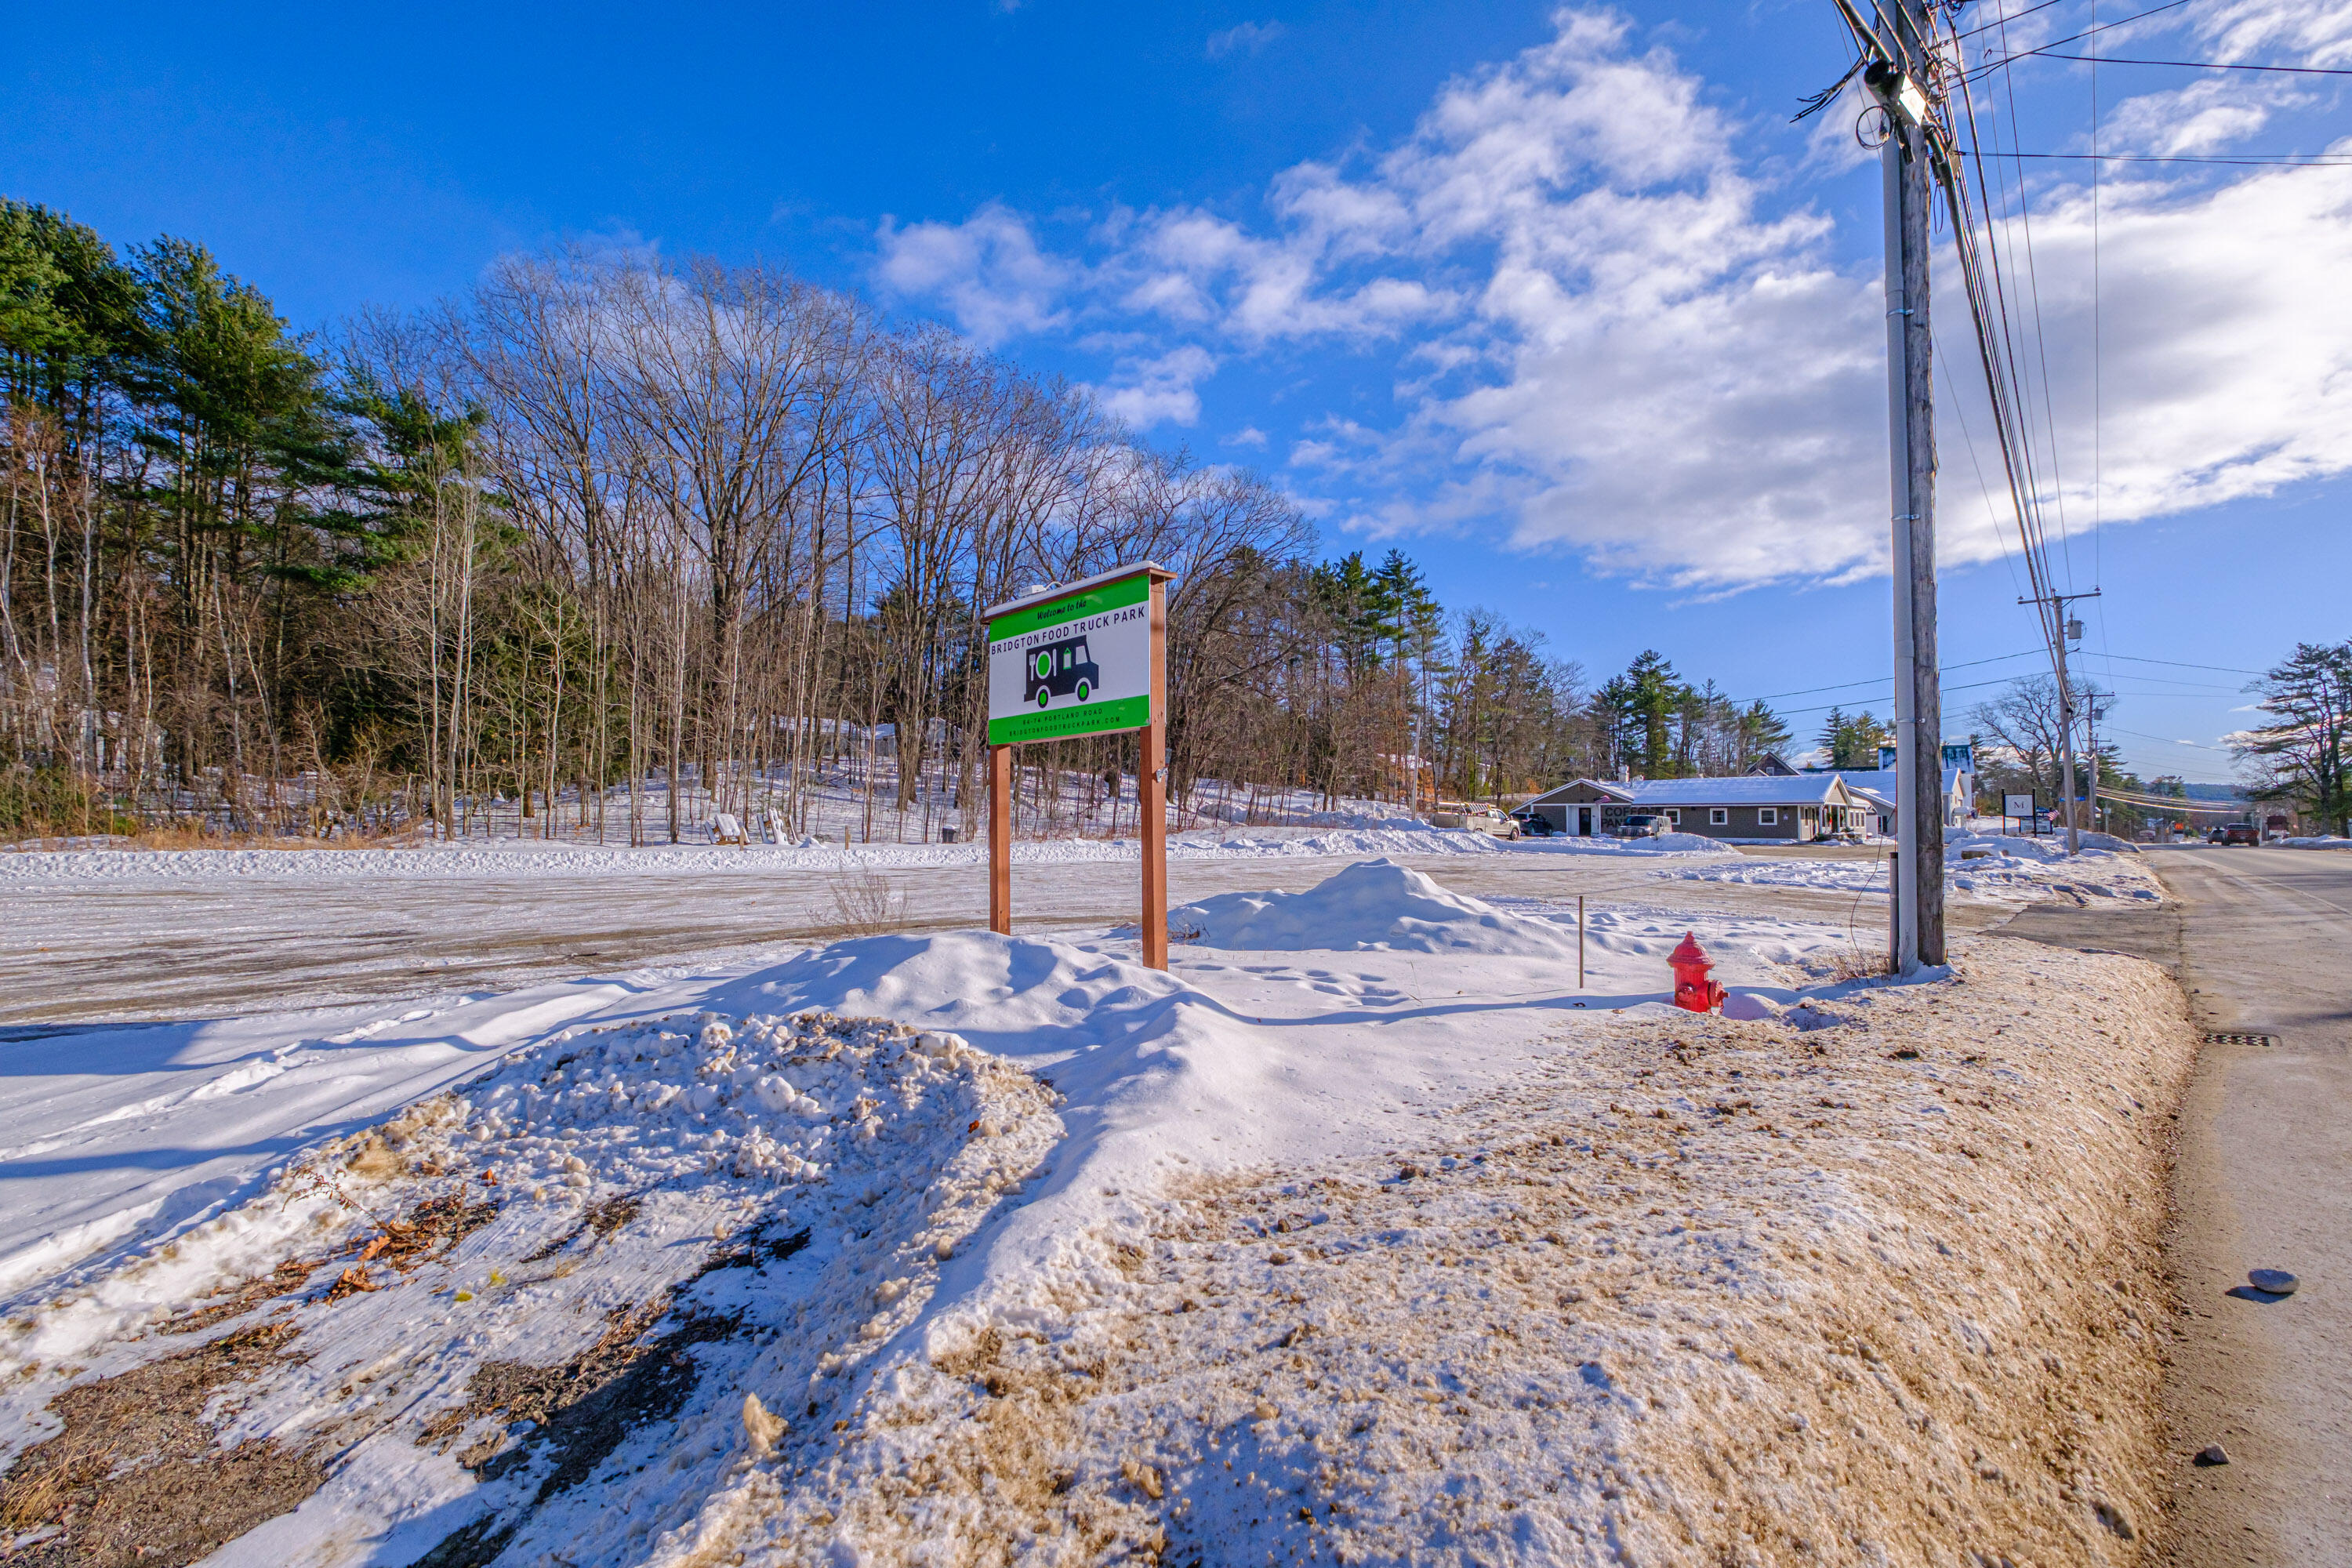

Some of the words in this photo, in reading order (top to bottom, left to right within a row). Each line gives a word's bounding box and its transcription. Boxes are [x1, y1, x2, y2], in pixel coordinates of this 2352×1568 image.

[1037, 606, 1065, 620] Welcome
[1067, 603, 1074, 612] to
[1076, 599, 1087, 609] the
[991, 633, 1039, 655] BRIDGTON
[1042, 629, 1069, 643] FOOD
[1073, 615, 1109, 634] TRUCK
[1114, 606, 1145, 624] PARK
[1044, 711, 1080, 722] PORTLAND
[1083, 708, 1102, 717] ROAD
